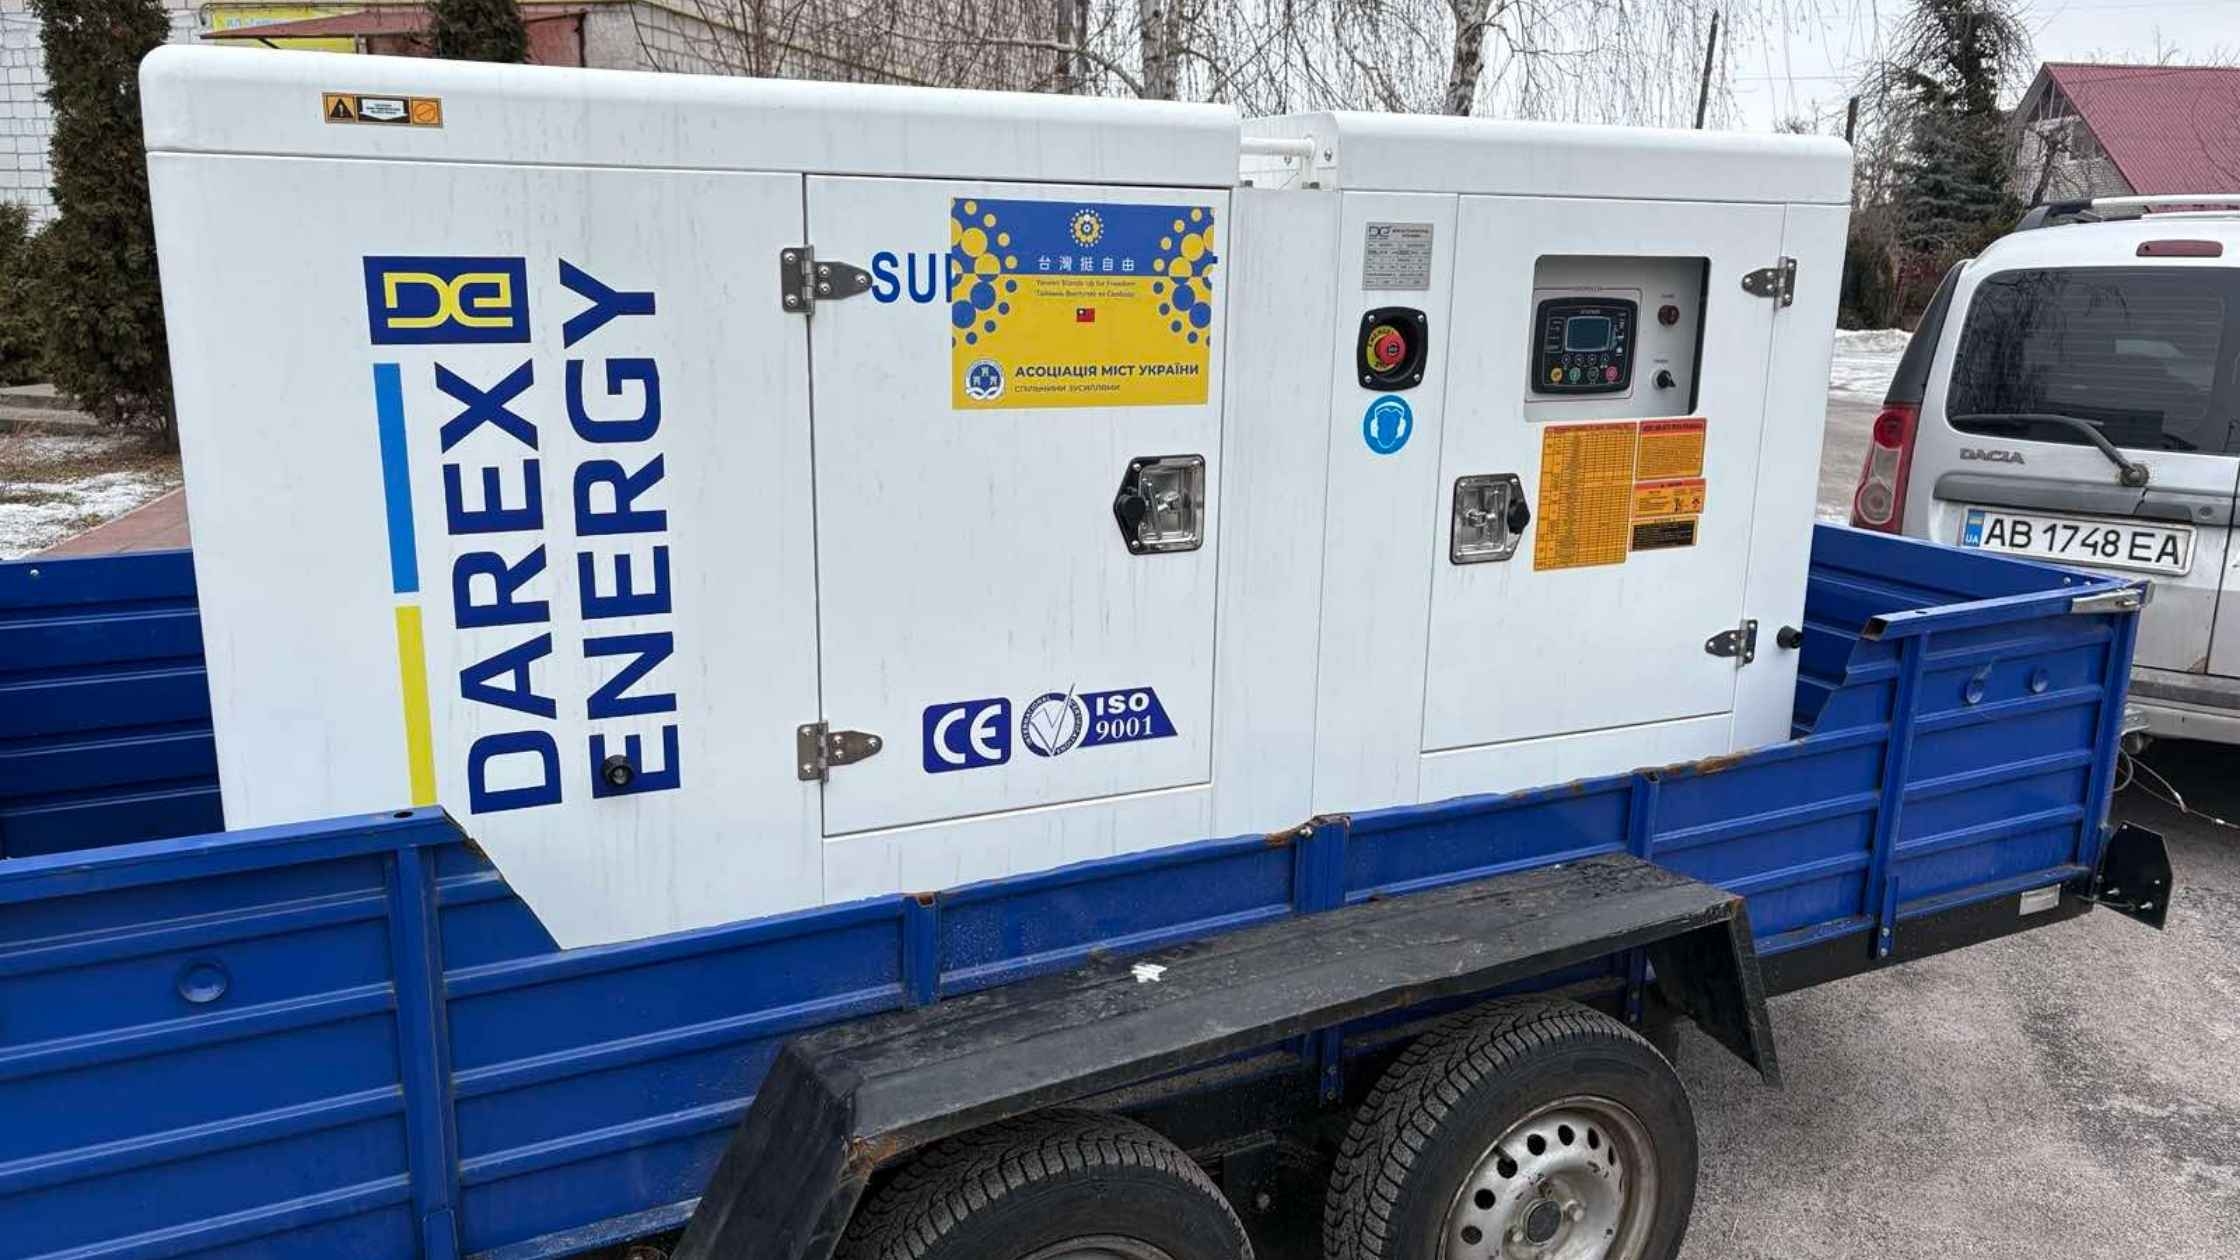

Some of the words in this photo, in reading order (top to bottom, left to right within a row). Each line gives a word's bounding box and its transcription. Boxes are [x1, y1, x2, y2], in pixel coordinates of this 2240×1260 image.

[1015, 364, 1097, 378] АСОЦІАЦІЯ
[1101, 364, 1136, 377] МІСТ
[1139, 363, 1199, 376] УКРАЇНИ
[1959, 448, 2025, 465] DACIA
[558, 257, 682, 800] ENERGY
[1965, 533, 1979, 545] UA
[1984, 519, 2033, 549] AB
[2042, 523, 2121, 558] 1748
[2128, 531, 2180, 565] EA
[434, 358, 563, 815] DAREX
[1096, 692, 1150, 716] ISO
[933, 703, 1002, 764] CE
[1096, 714, 1153, 741] 9001
